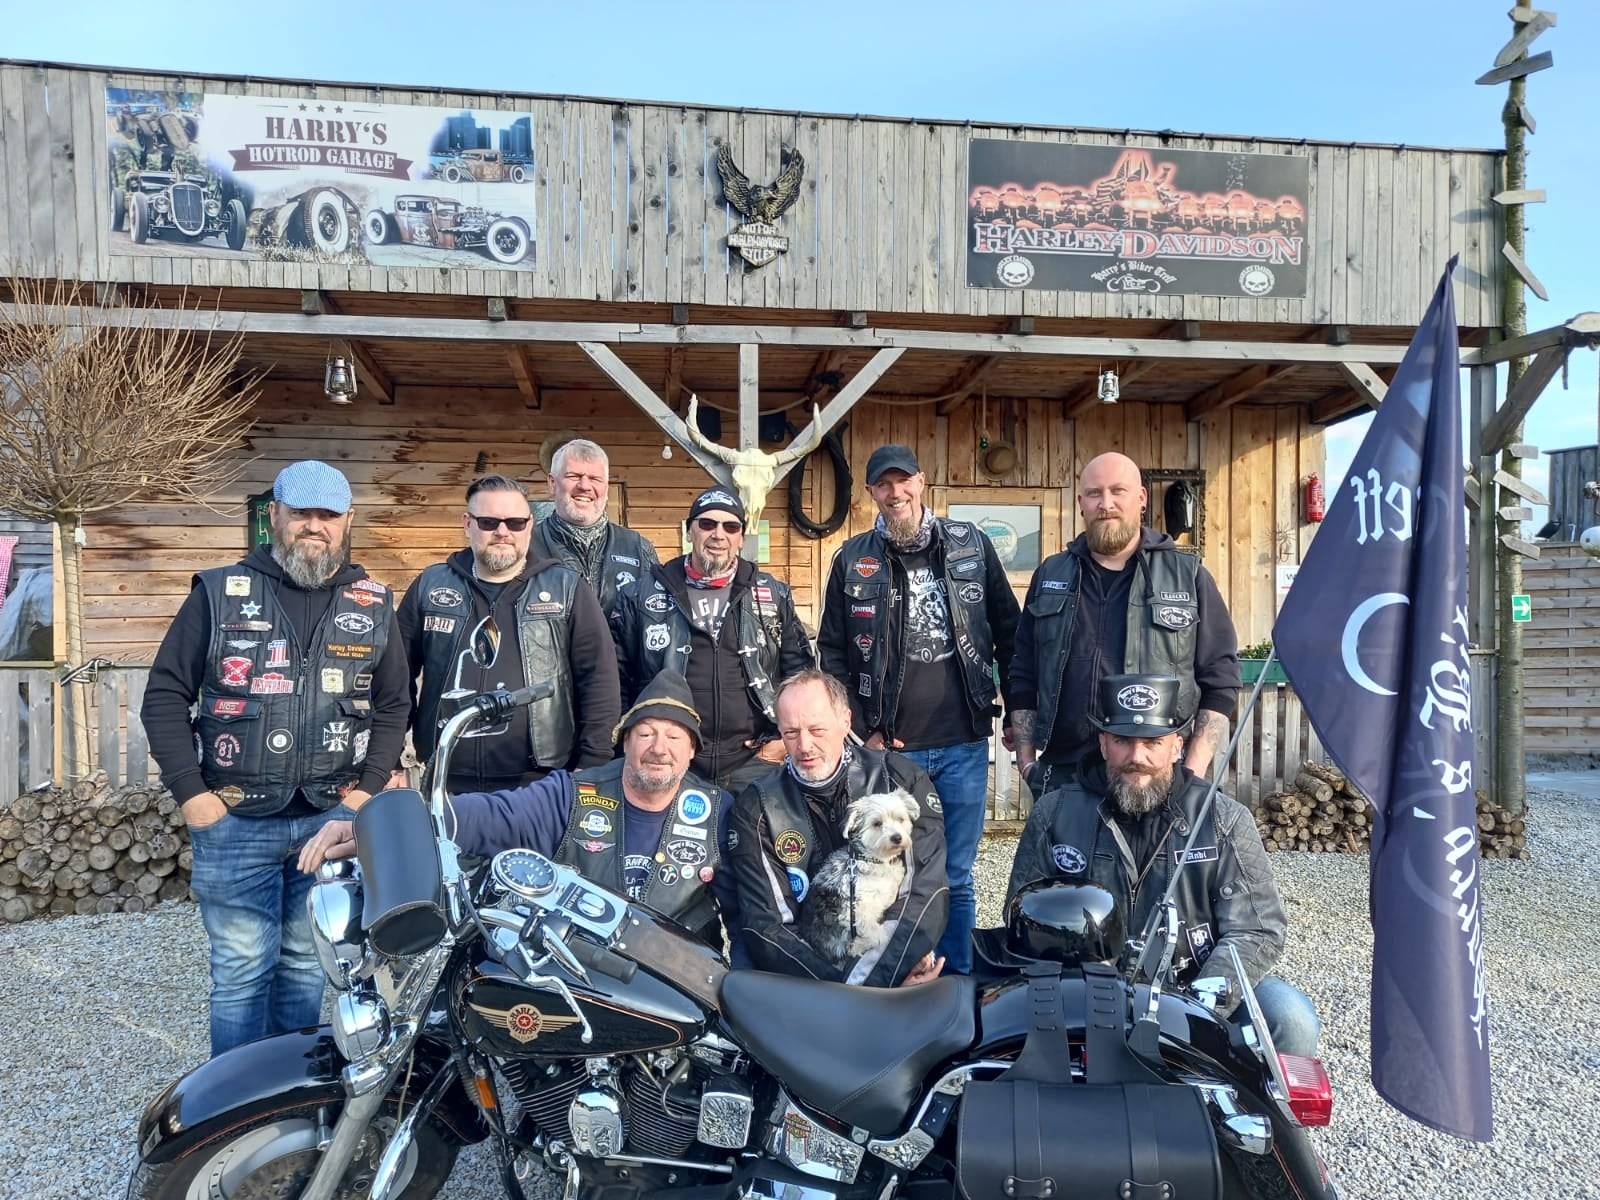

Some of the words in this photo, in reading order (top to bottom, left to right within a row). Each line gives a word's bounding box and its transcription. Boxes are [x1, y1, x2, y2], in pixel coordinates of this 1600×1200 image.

[265, 116, 388, 146] HARRY'S
[249, 146, 321, 164] HOTROD
[326, 151, 395, 170] GARAGE
[650, 634, 666, 647] 66
[959, 633, 981, 665] RIDE
[218, 740, 233, 759] 81
[582, 796, 615, 809] HONDA
